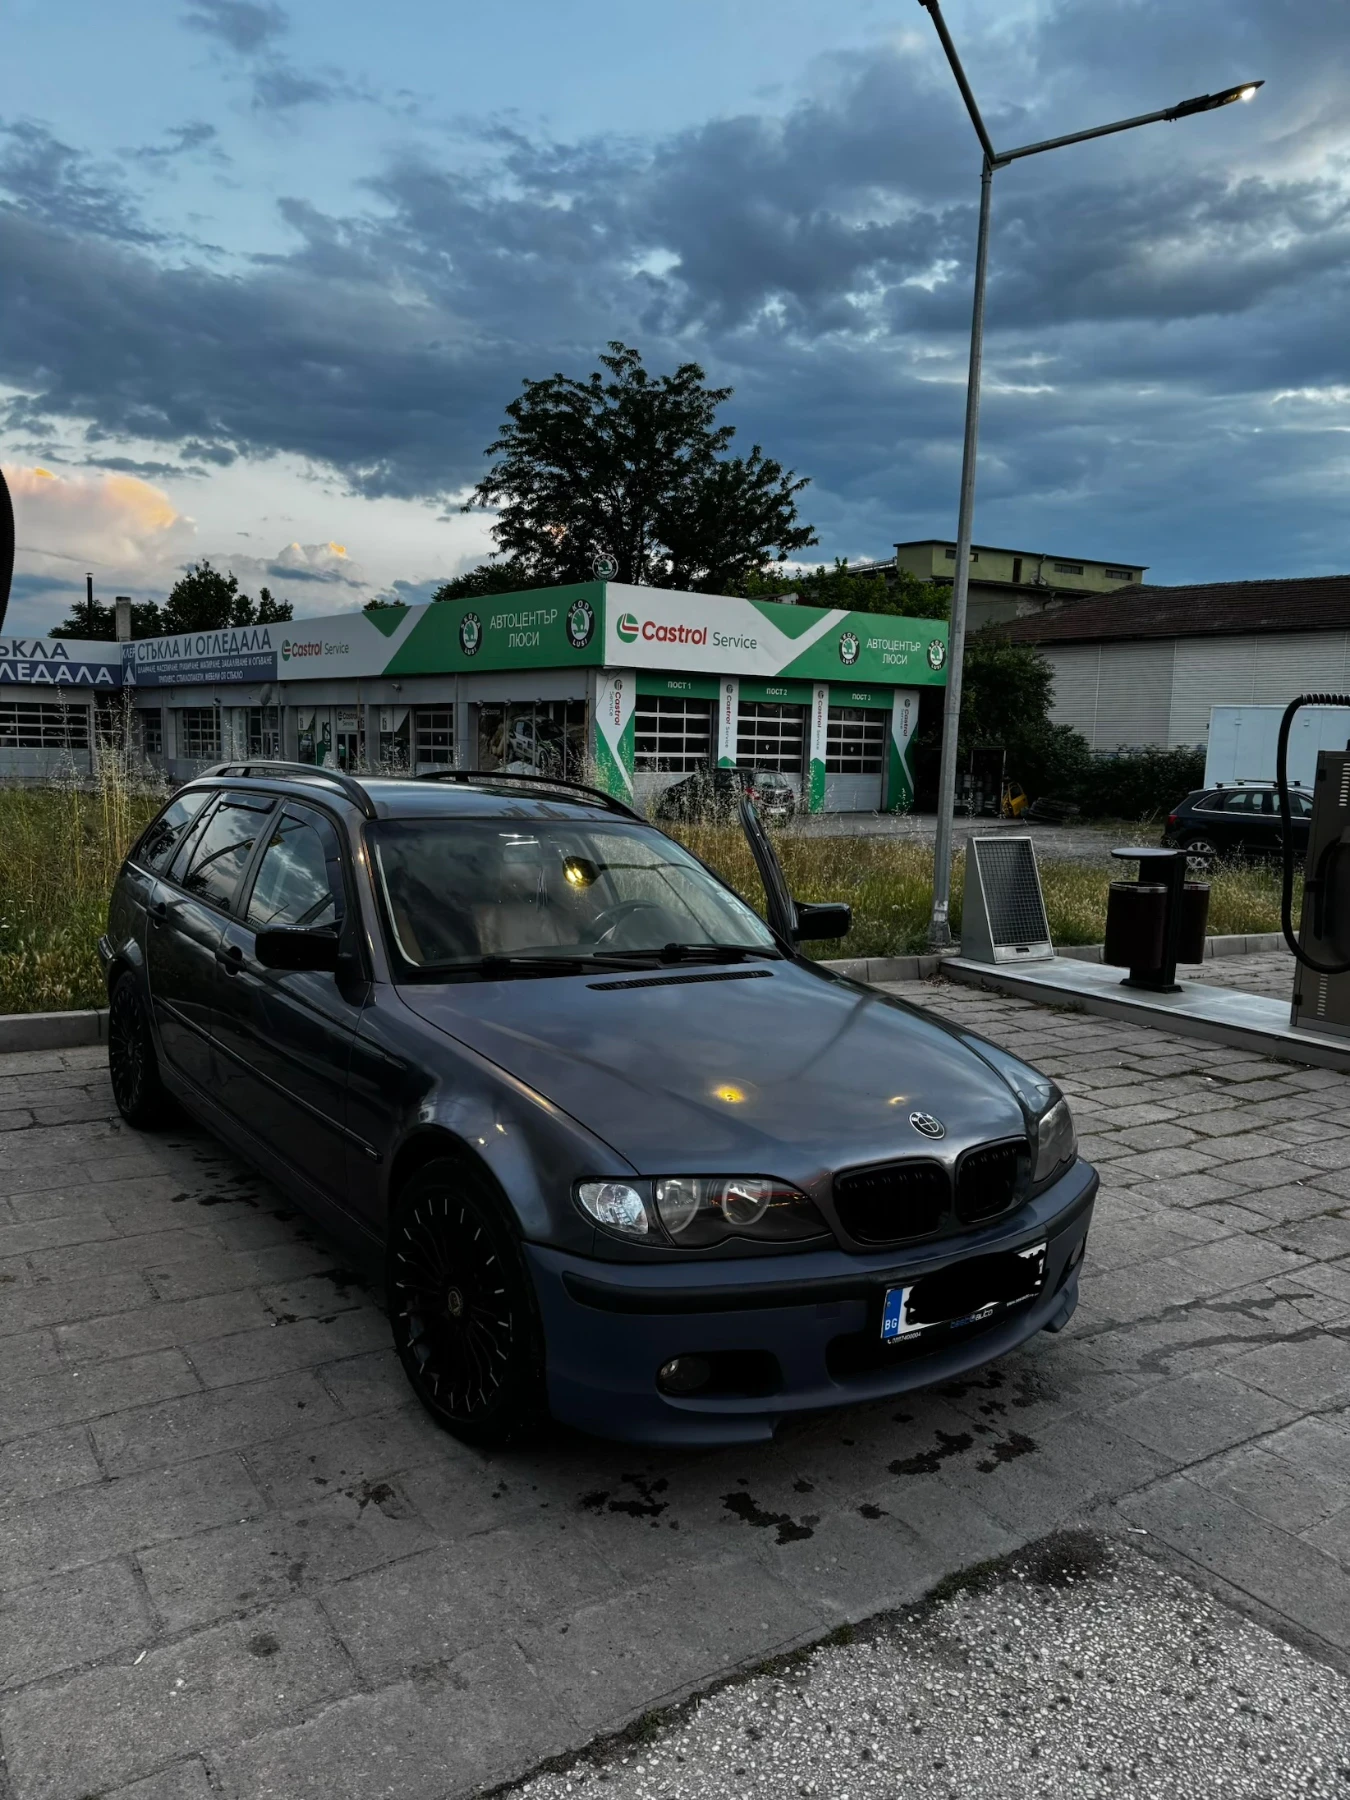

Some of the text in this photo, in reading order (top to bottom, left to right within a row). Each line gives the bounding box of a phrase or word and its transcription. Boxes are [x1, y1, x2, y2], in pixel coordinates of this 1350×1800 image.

[568, 600, 593, 618] SKODA
[461, 613, 481, 629] SKODA
[490, 609, 558, 630] АВТОЦЕНТЪР
[508, 631, 540, 648] ЛЮСИ
[573, 639, 588, 647] LUSI
[642, 621, 757, 649] Castrol Service
[840, 632, 859, 646] SKODA
[137, 628, 272, 661] СТЪКЛА И ОГЛЕДАЛА
[292, 640, 349, 658] Castrol Service
[465, 647, 477, 655] LUSI
[866, 638, 921, 652] АВТОЦЕНТЪР
[882, 653, 908, 664] ЛЮСИ
[668, 681, 686, 689] ПОСТ
[614, 691, 622, 726] Castrol
[885, 1318, 898, 1331] BG
